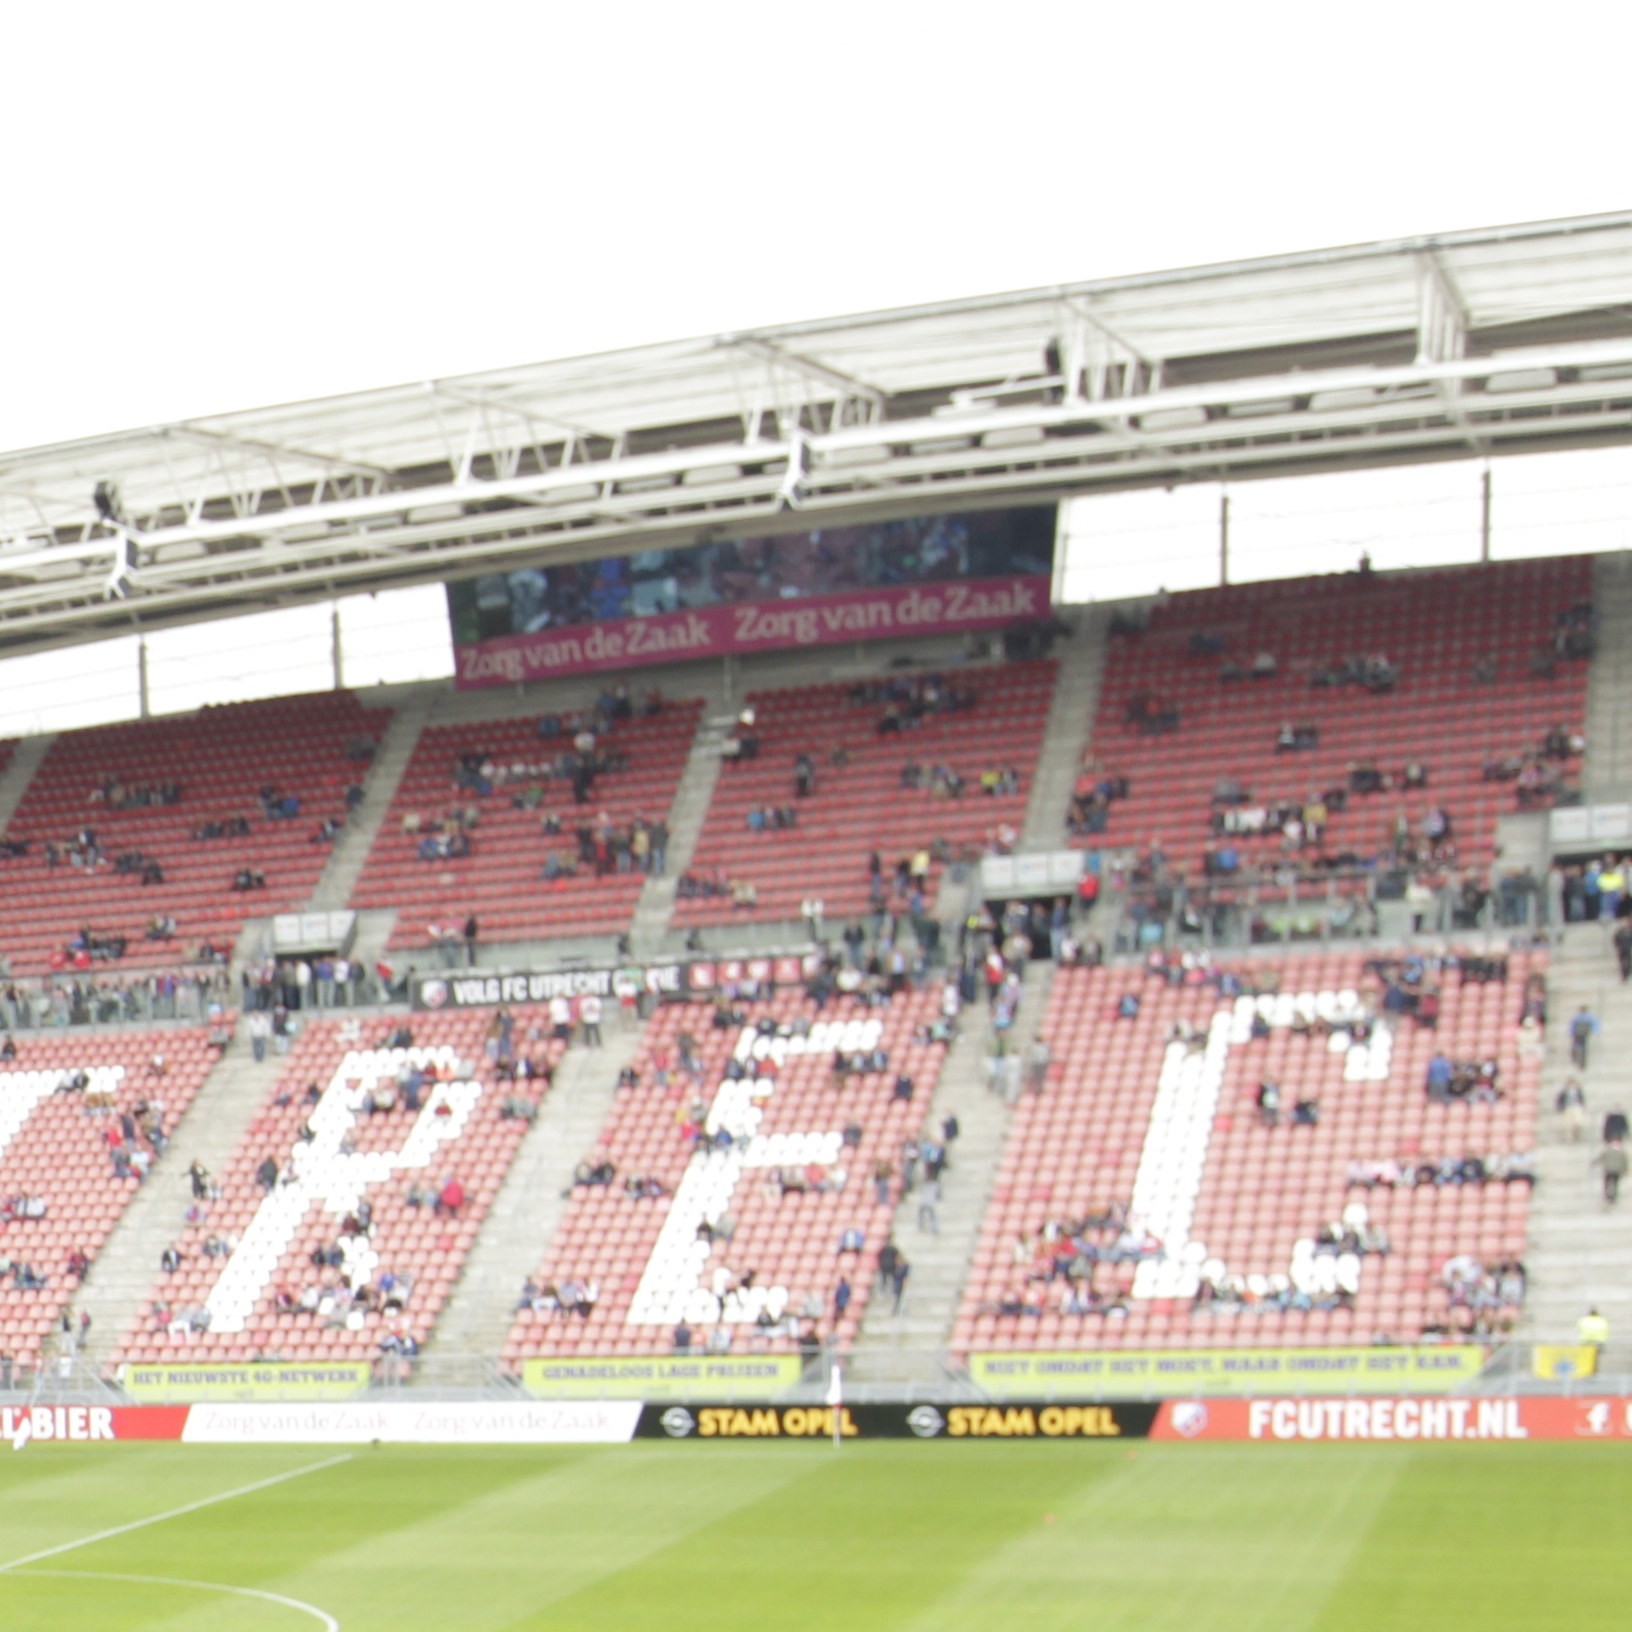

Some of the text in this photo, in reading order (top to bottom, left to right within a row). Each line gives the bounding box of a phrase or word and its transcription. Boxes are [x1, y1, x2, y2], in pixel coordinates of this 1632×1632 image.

[734, 582, 1035, 643] Zorg van de Zaak
[459, 614, 712, 681] Zorg van de Zaak
[453, 978, 500, 1005] VOLG
[502, 976, 528, 1001] FC
[31, 1405, 115, 1440] BIER
[698, 1408, 858, 1436] STAM OPEL
[947, 1407, 1120, 1436] STAM OPEL
[1248, 1400, 1528, 1440] FCUTRECHT.NL
